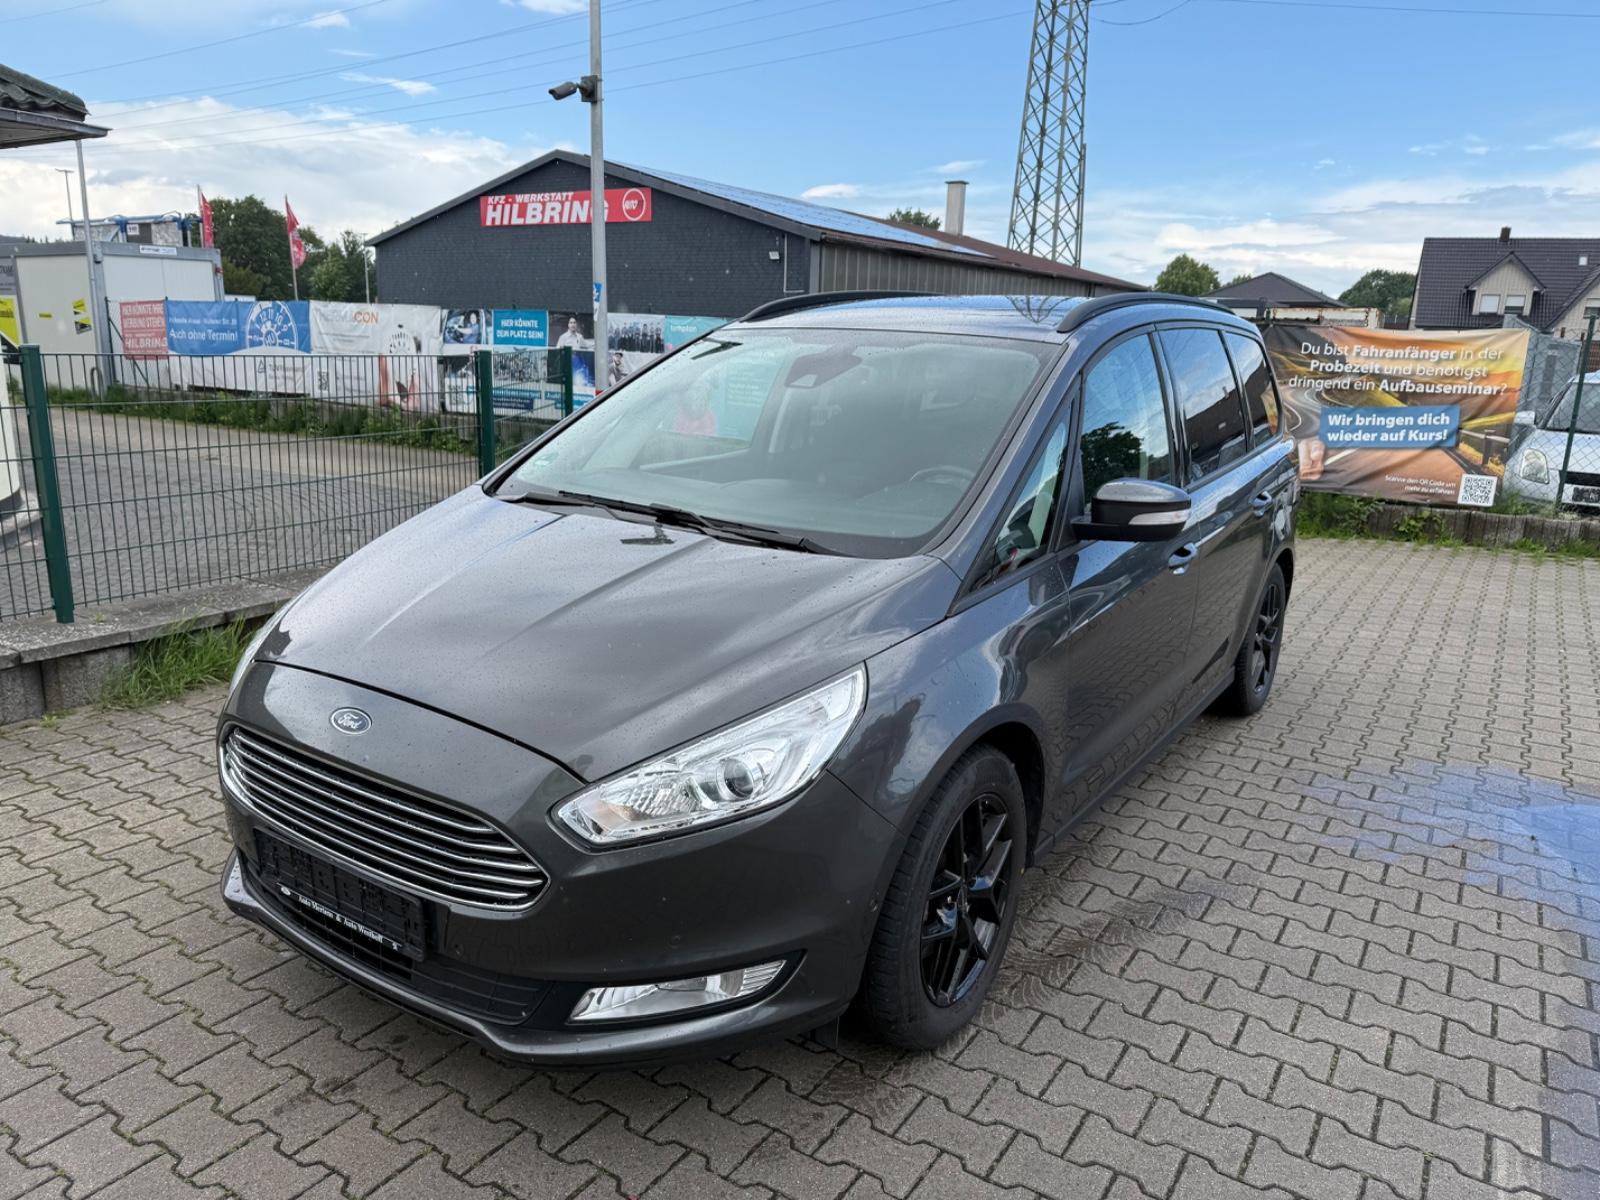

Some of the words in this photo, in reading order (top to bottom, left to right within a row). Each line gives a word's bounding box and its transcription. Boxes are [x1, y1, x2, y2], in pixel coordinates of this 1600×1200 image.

[488, 196, 506, 205] KFZ
[515, 192, 574, 203] WERKSTATT
[501, 319, 513, 327] HIER
[514, 317, 538, 328] KÖNNTE
[169, 327, 186, 339] Auch
[187, 328, 206, 340] ohne
[207, 328, 238, 341] Termin!
[496, 329, 510, 338] DEIN
[510, 330, 527, 338] PLATZ
[528, 331, 544, 339] SEIN!
[1300, 342, 1321, 355] Du
[1323, 343, 1349, 356] bist
[1352, 345, 1457, 361] Fahranfänger
[1459, 347, 1474, 360] in
[1478, 347, 1505, 360] der
[1310, 360, 1381, 374] Probezeit
[1383, 363, 1412, 375] und
[1416, 364, 1489, 379] benötigst
[1288, 375, 1351, 392] dringend
[1353, 379, 1375, 391] ein
[1379, 379, 1508, 396] Aufbauseminar?
[1327, 414, 1353, 426] Wir
[1355, 413, 1414, 429] bringen
[1417, 412, 1450, 426] dich
[1327, 430, 1378, 442] wieder
[1380, 429, 1406, 442] auf
[1407, 429, 1448, 442] Kurs!
[1385, 475, 1406, 484] Scanne
[337, 712, 363, 730] Ford
[299, 895, 312, 908] Auto
[343, 918, 358, 931] Auto
